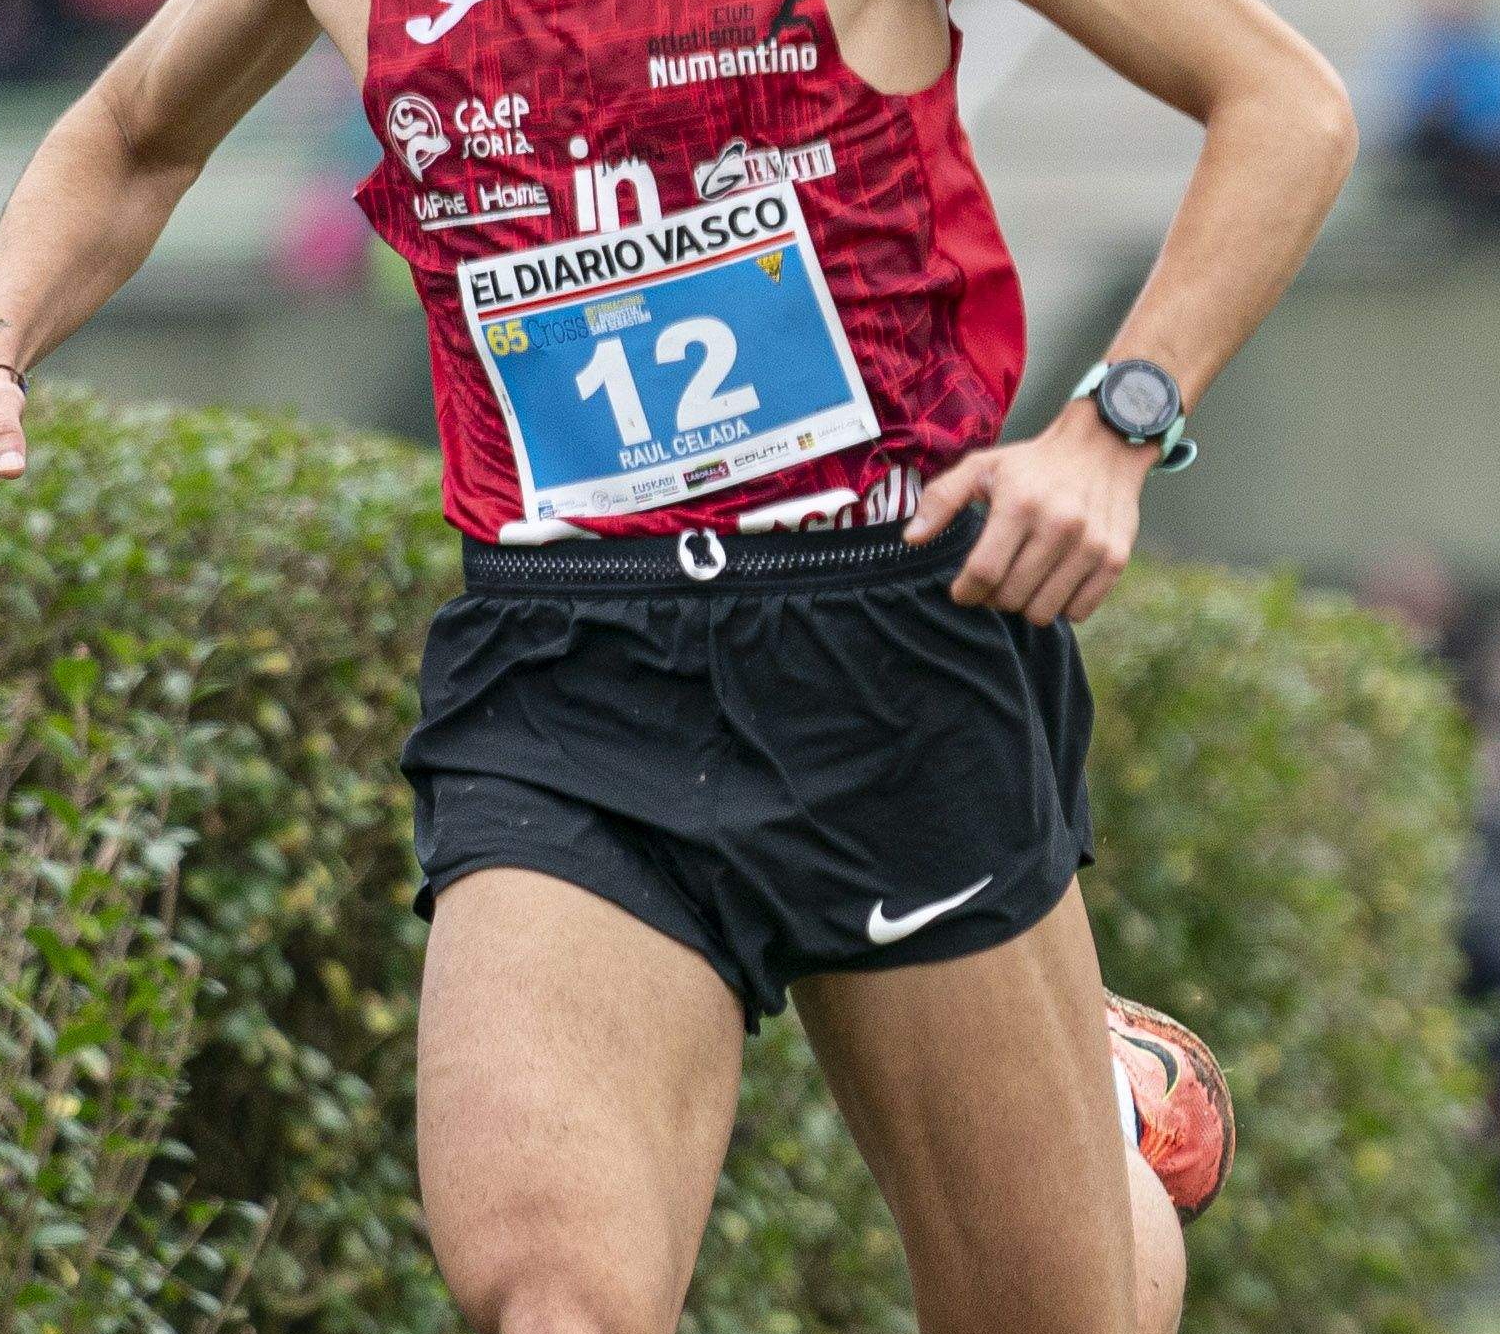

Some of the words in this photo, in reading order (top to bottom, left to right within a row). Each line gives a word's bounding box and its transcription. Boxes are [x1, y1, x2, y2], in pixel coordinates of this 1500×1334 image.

[649, 36, 818, 89] Numantino
[471, 271, 514, 309] EL
[513, 238, 646, 301] DIARIO
[646, 196, 789, 266] VASCO
[487, 320, 530, 357] 65
[526, 316, 590, 350] Cross
[575, 315, 761, 447] 12
[618, 441, 672, 470] RAUL
[672, 417, 751, 456] CELADA
